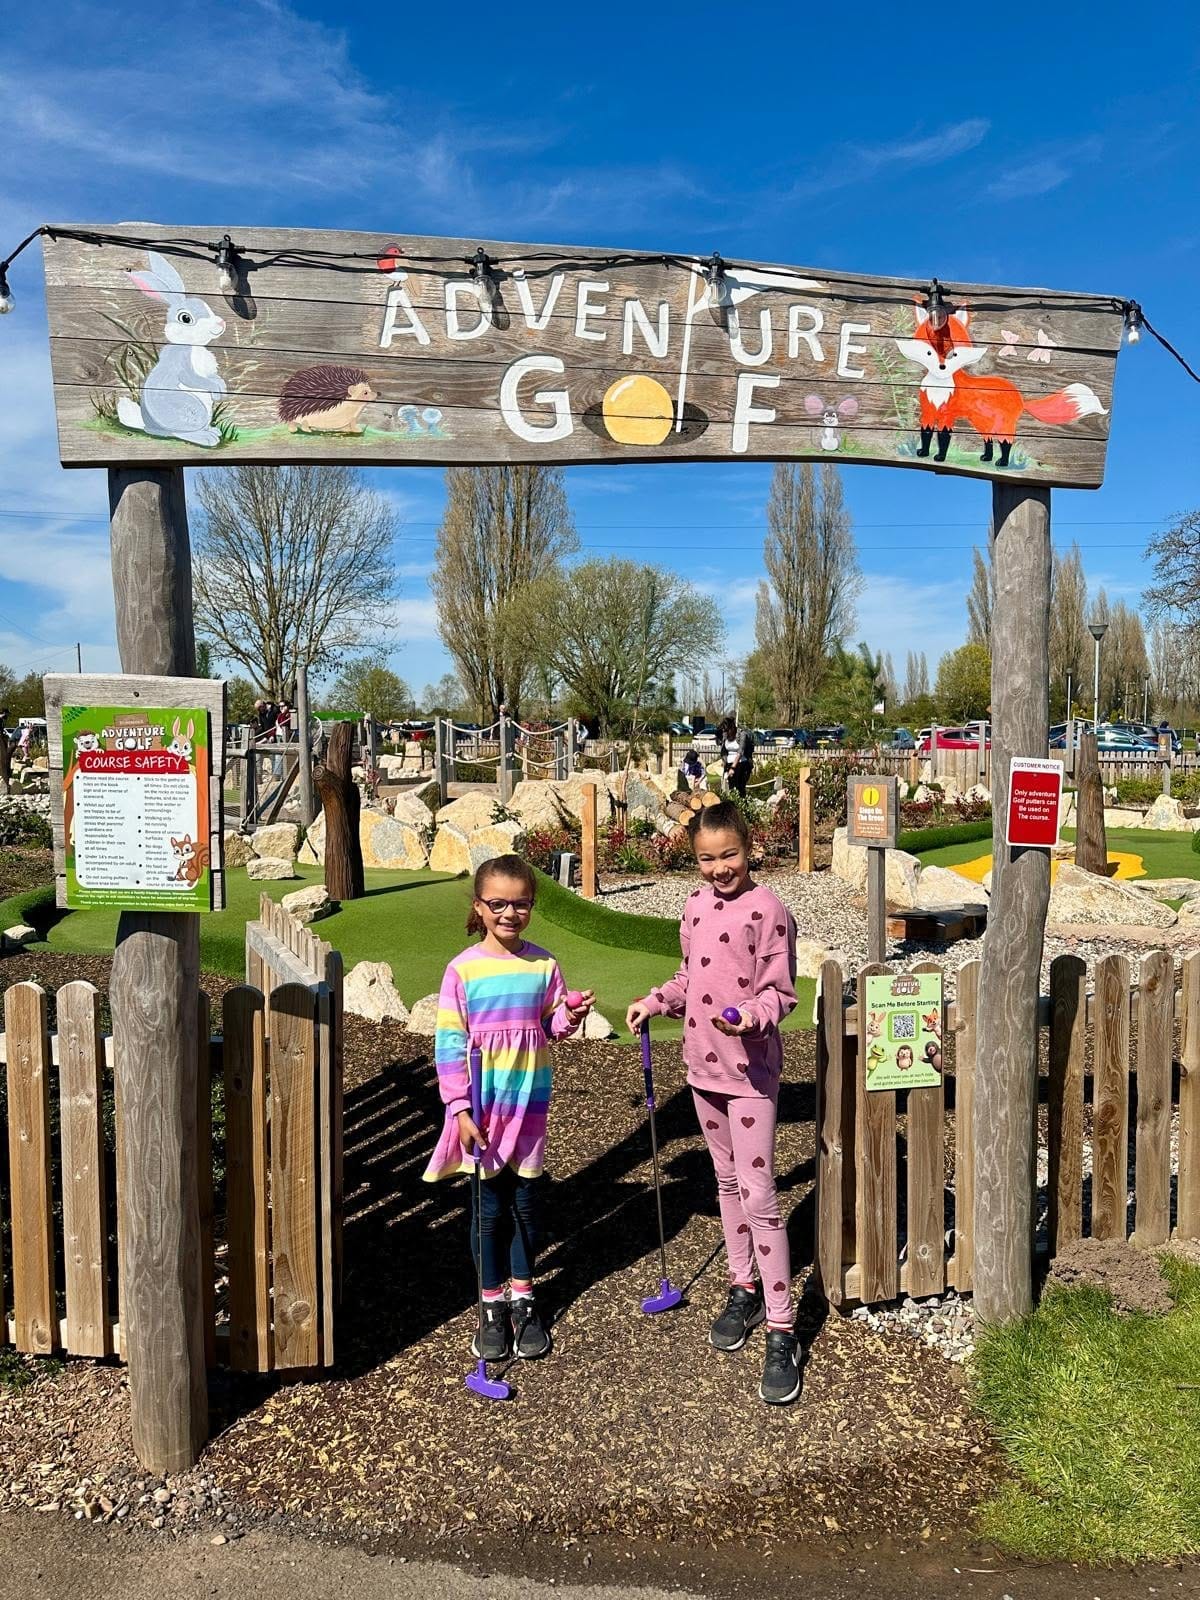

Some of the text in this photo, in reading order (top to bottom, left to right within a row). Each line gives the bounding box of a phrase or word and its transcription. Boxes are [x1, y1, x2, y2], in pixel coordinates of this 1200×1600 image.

[379, 257, 872, 380] ADVENTURE
[500, 353, 782, 454] GOLF
[101, 726, 165, 738] ADVENTURE
[115, 737, 153, 750] GOLF
[85, 755, 182, 769] COURSE SAFETY
[1015, 788, 1056, 798] Only adventure
[1018, 812, 1028, 820] The
